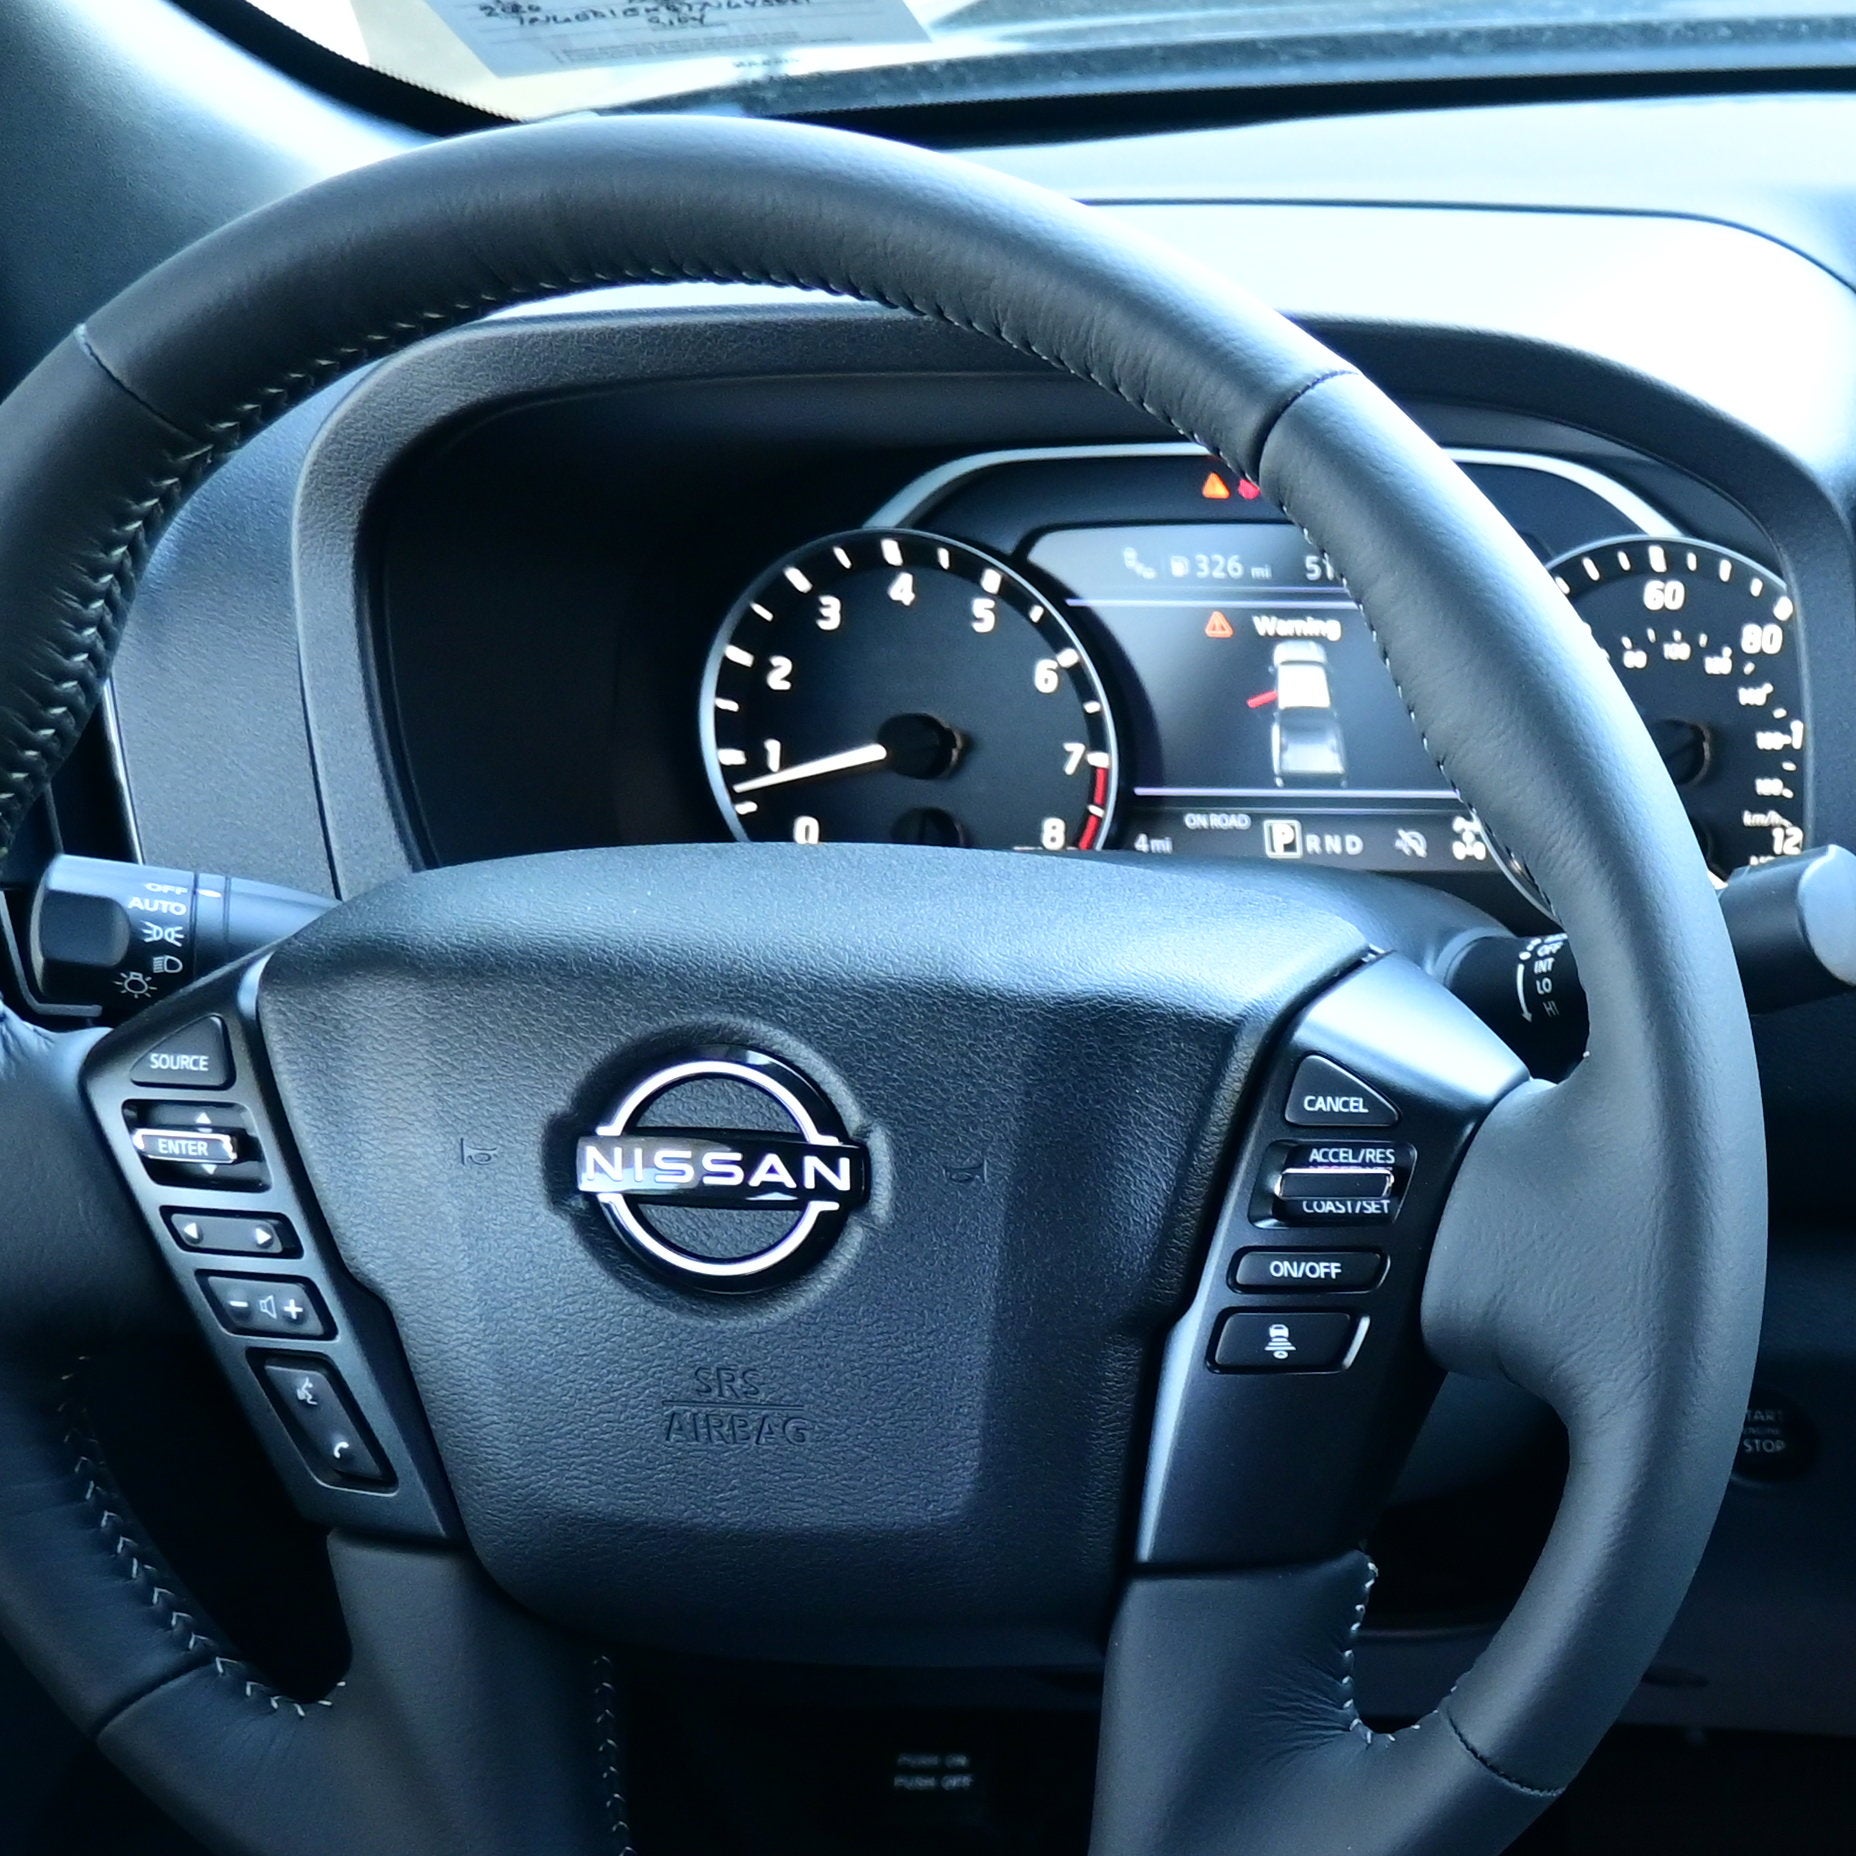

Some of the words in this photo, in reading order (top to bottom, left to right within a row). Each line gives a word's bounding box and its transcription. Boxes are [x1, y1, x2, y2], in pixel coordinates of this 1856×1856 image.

[1195, 554, 1244, 578] 326
[1251, 563, 1272, 580] mi
[888, 572, 916, 606] 4
[1644, 580, 1685, 610] 60
[816, 595, 841, 631] 3
[972, 598, 995, 633] 5
[1252, 615, 1342, 641] Warning
[1741, 623, 1783, 654] 80
[766, 655, 793, 691] 2
[1034, 658, 1059, 693] 6
[764, 737, 781, 773] 1
[1062, 742, 1086, 775] 7
[1041, 817, 1066, 850] 8
[1185, 813, 1208, 829] ON
[1210, 814, 1251, 830] ROAD
[144, 883, 188, 895] OFF
[128, 897, 187, 916] AUTO
[1535, 977, 1553, 995] LO
[150, 1053, 209, 1071] SOURCE
[1303, 1096, 1369, 1113] CANCEL
[157, 1139, 208, 1156] ENTER
[1308, 1148, 1396, 1164] ACCEL/RES
[585, 1146, 850, 1191] NISSAN
[1269, 1261, 1342, 1280] ON/OFF
[694, 1366, 762, 1399] SRS
[664, 1411, 810, 1446] AIRBAG
